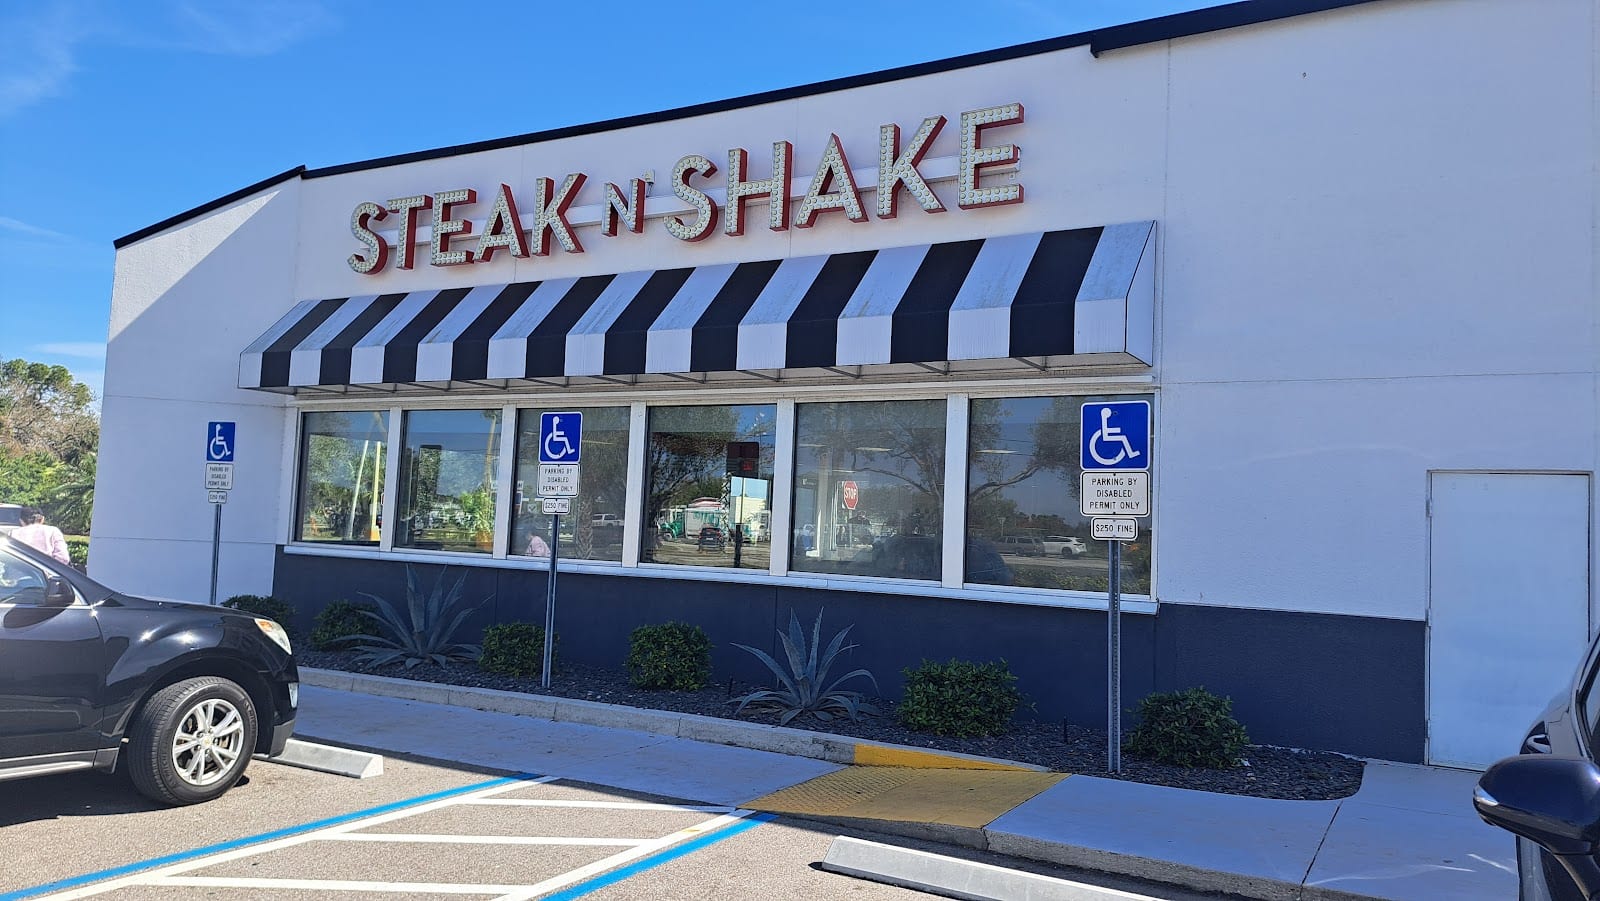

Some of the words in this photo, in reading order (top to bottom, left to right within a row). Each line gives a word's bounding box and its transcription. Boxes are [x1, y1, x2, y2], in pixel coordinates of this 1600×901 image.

[347, 173, 588, 275] STEAK
[663, 102, 1025, 242] SHAKE
[1091, 478, 1124, 486] PARKING
[1127, 478, 1138, 486] BY
[845, 487, 857, 499] STOP
[1096, 489, 1133, 498] DISABLED
[1089, 501, 1117, 510] PERMIT
[1120, 501, 1140, 510] ONLY
[1095, 523, 1114, 533] $250
[1117, 523, 1134, 533] FINE
